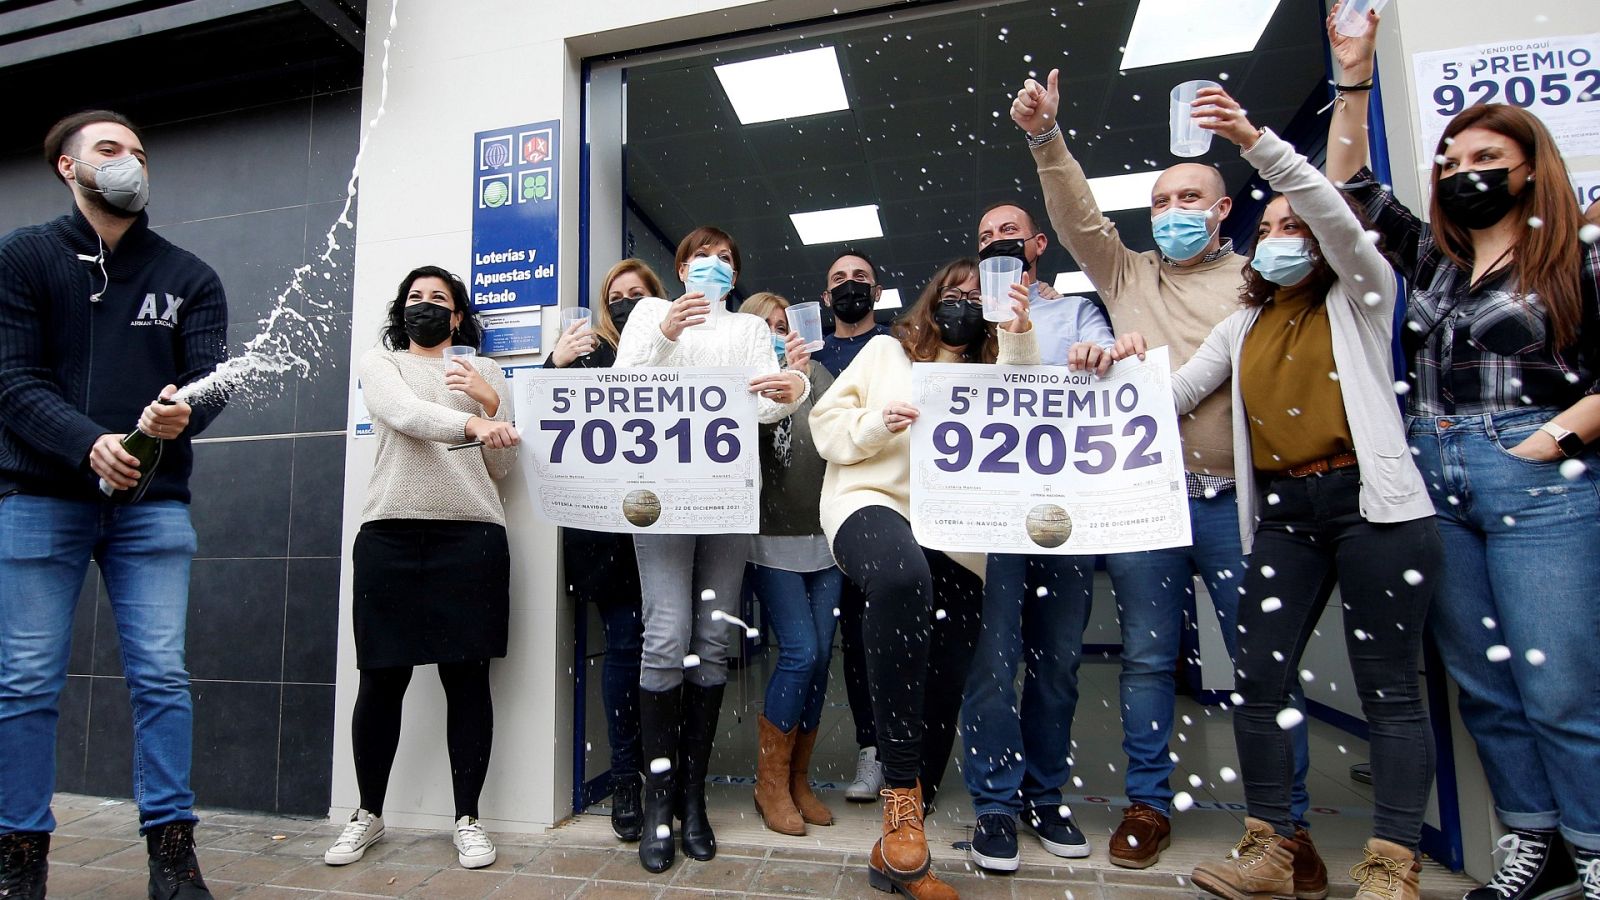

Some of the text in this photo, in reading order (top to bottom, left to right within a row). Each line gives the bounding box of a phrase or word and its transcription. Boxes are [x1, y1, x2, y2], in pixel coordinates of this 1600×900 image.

[1480, 42, 1550, 55] VENDIDO AQUÍ
[1470, 48, 1591, 78] PREMIO
[1433, 70, 1600, 116] 92052
[475, 249, 537, 266] Loterías y
[474, 264, 554, 288] Apuestas del
[474, 289, 516, 304] Estado
[597, 374, 680, 383] VENDIDO AQUÍ
[1003, 373, 1092, 385] VENDIDO AQUÍ
[552, 386, 727, 414] 5º PREMIO
[949, 382, 1139, 418] 5º PREMIO
[540, 418, 742, 464] 70316
[932, 415, 1162, 475] 92052
[1112, 518, 1149, 527] DICIEMBRE
